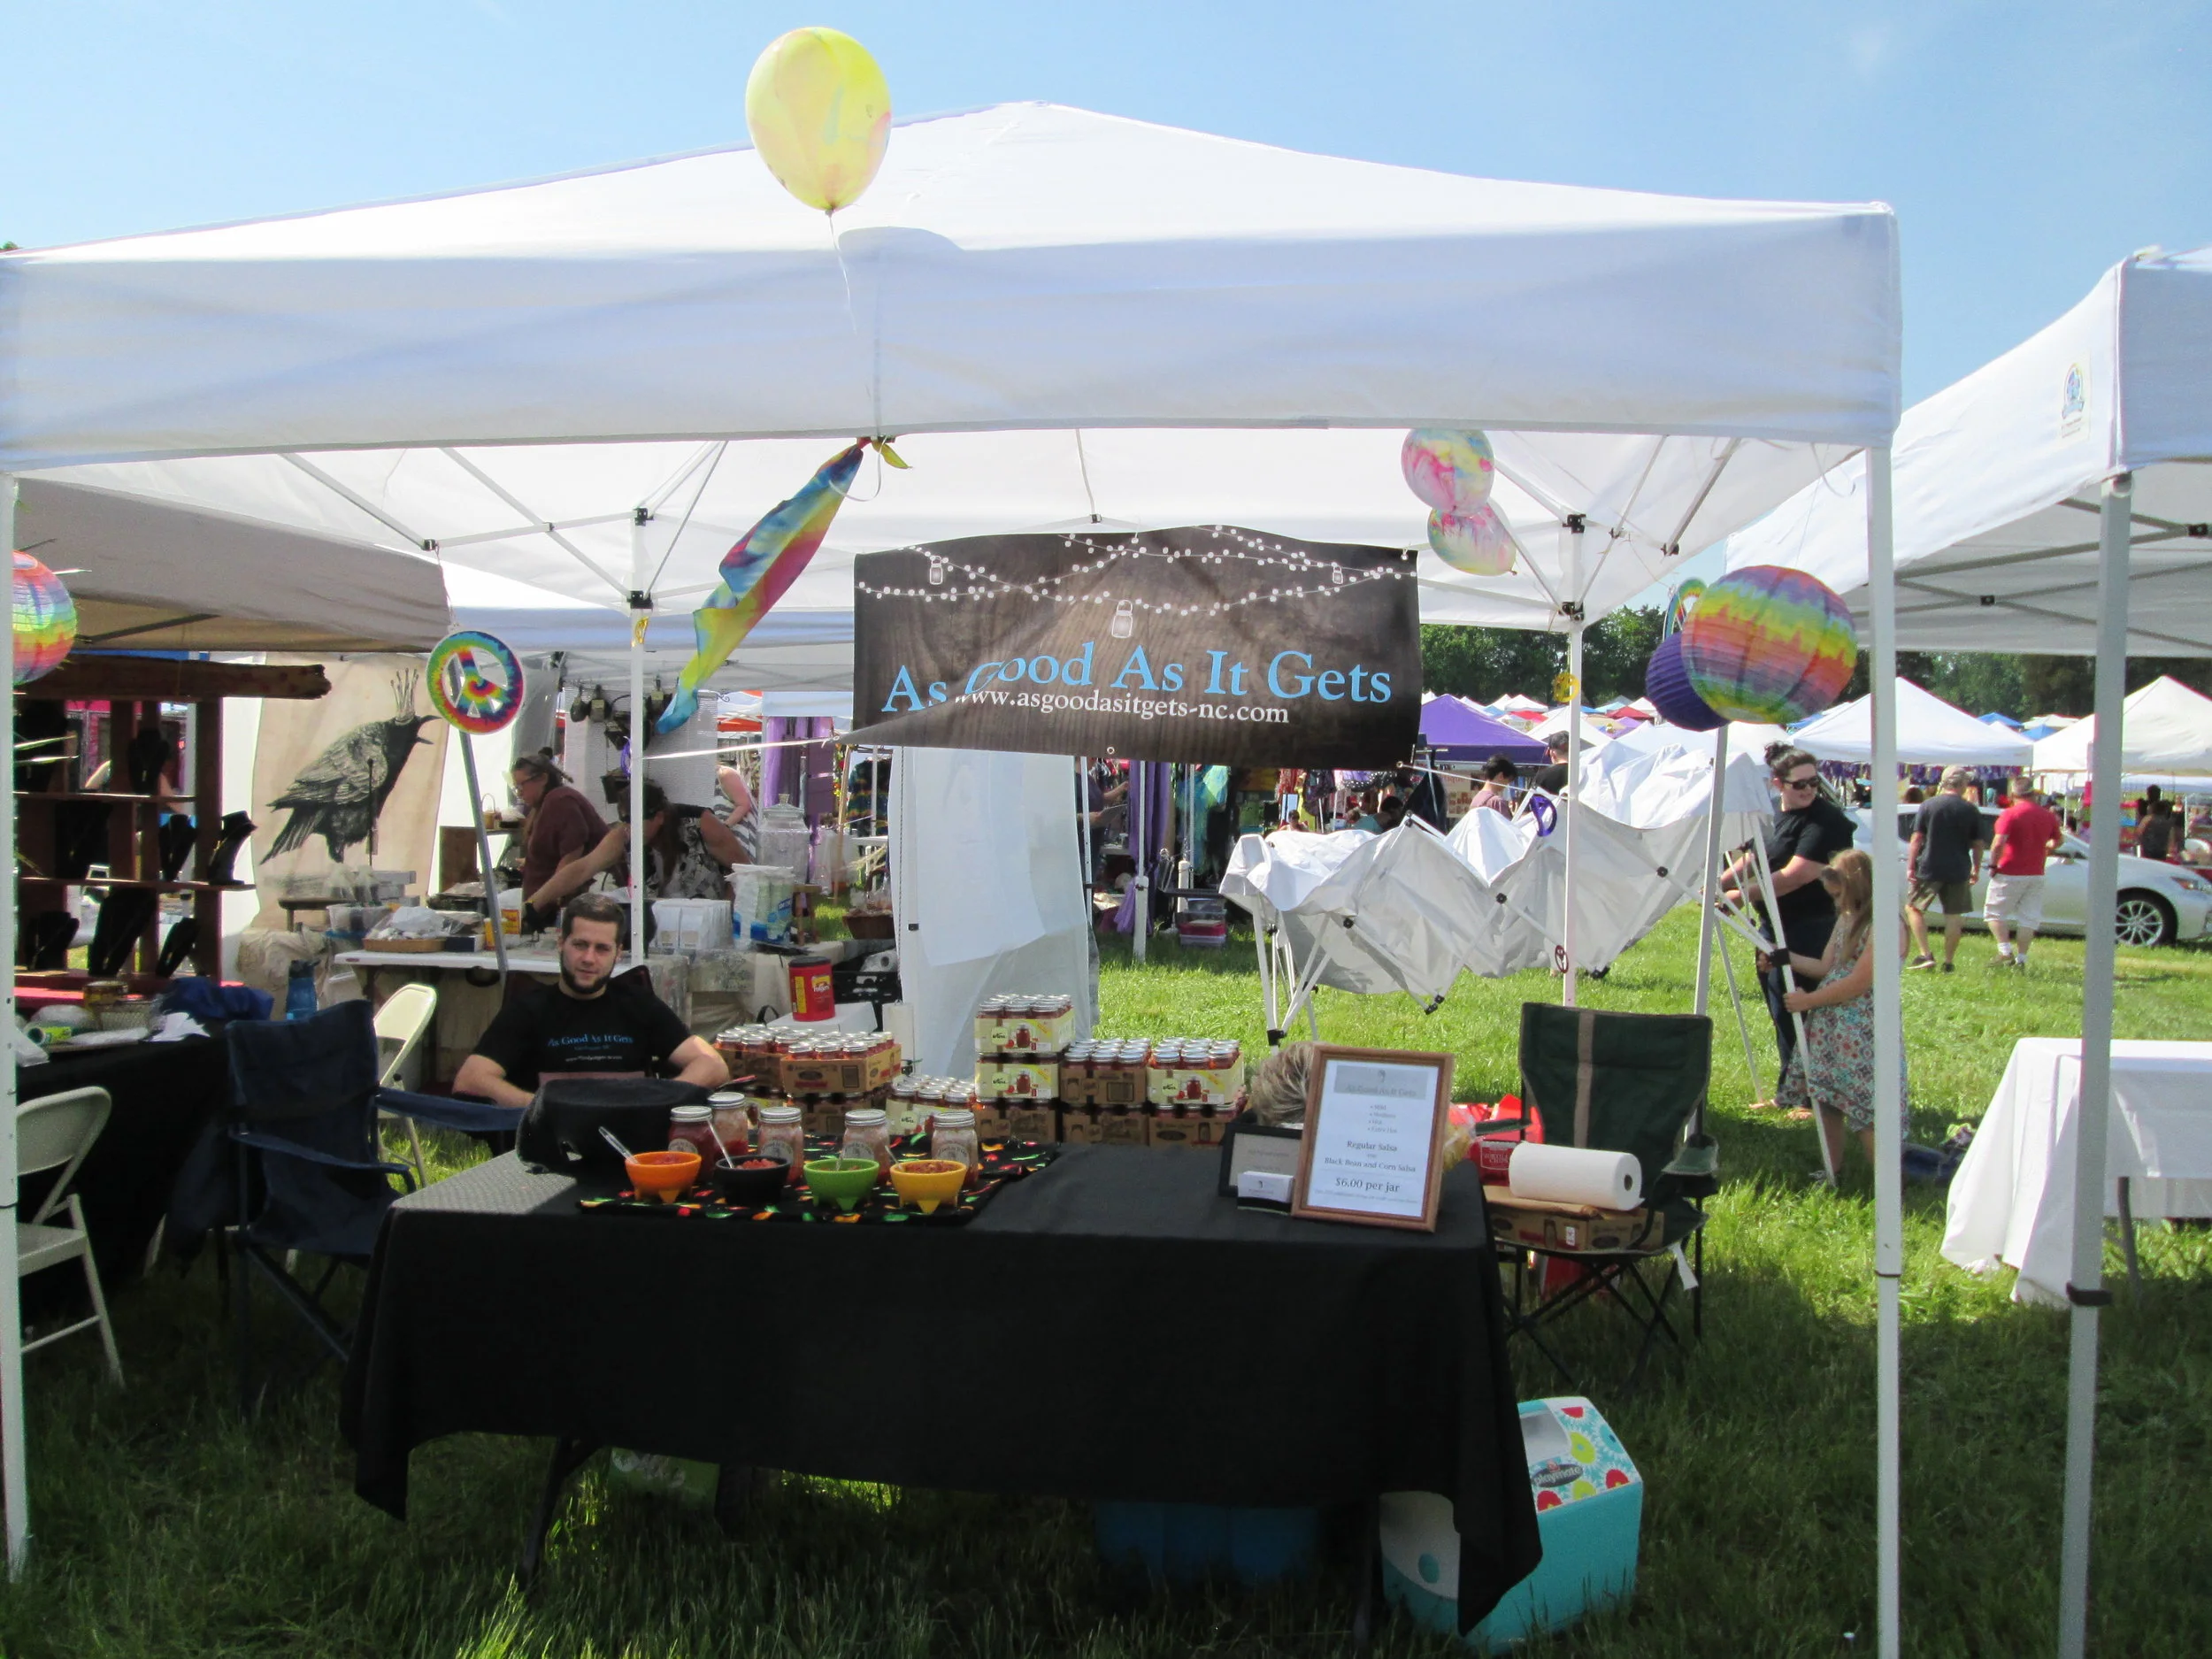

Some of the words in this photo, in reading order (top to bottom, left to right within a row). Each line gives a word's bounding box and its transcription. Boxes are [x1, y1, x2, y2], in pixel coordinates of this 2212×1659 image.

[881, 665, 948, 711] As
[964, 641, 1094, 695] Good
[1110, 645, 1184, 692] As
[1204, 649, 1250, 696] It
[1267, 650, 1392, 703] Gets
[955, 689, 1289, 724] www.asgoodasitgets-nc.com
[561, 1033, 588, 1045] Good
[1347, 1141, 1377, 1151] Regular
[1379, 1143, 1398, 1152] Salsa
[1398, 1164, 1417, 1172] Salsa
[1334, 1177, 1363, 1188] $6.00
[1365, 1181, 1384, 1191] per
[1384, 1182, 1401, 1193] jar
